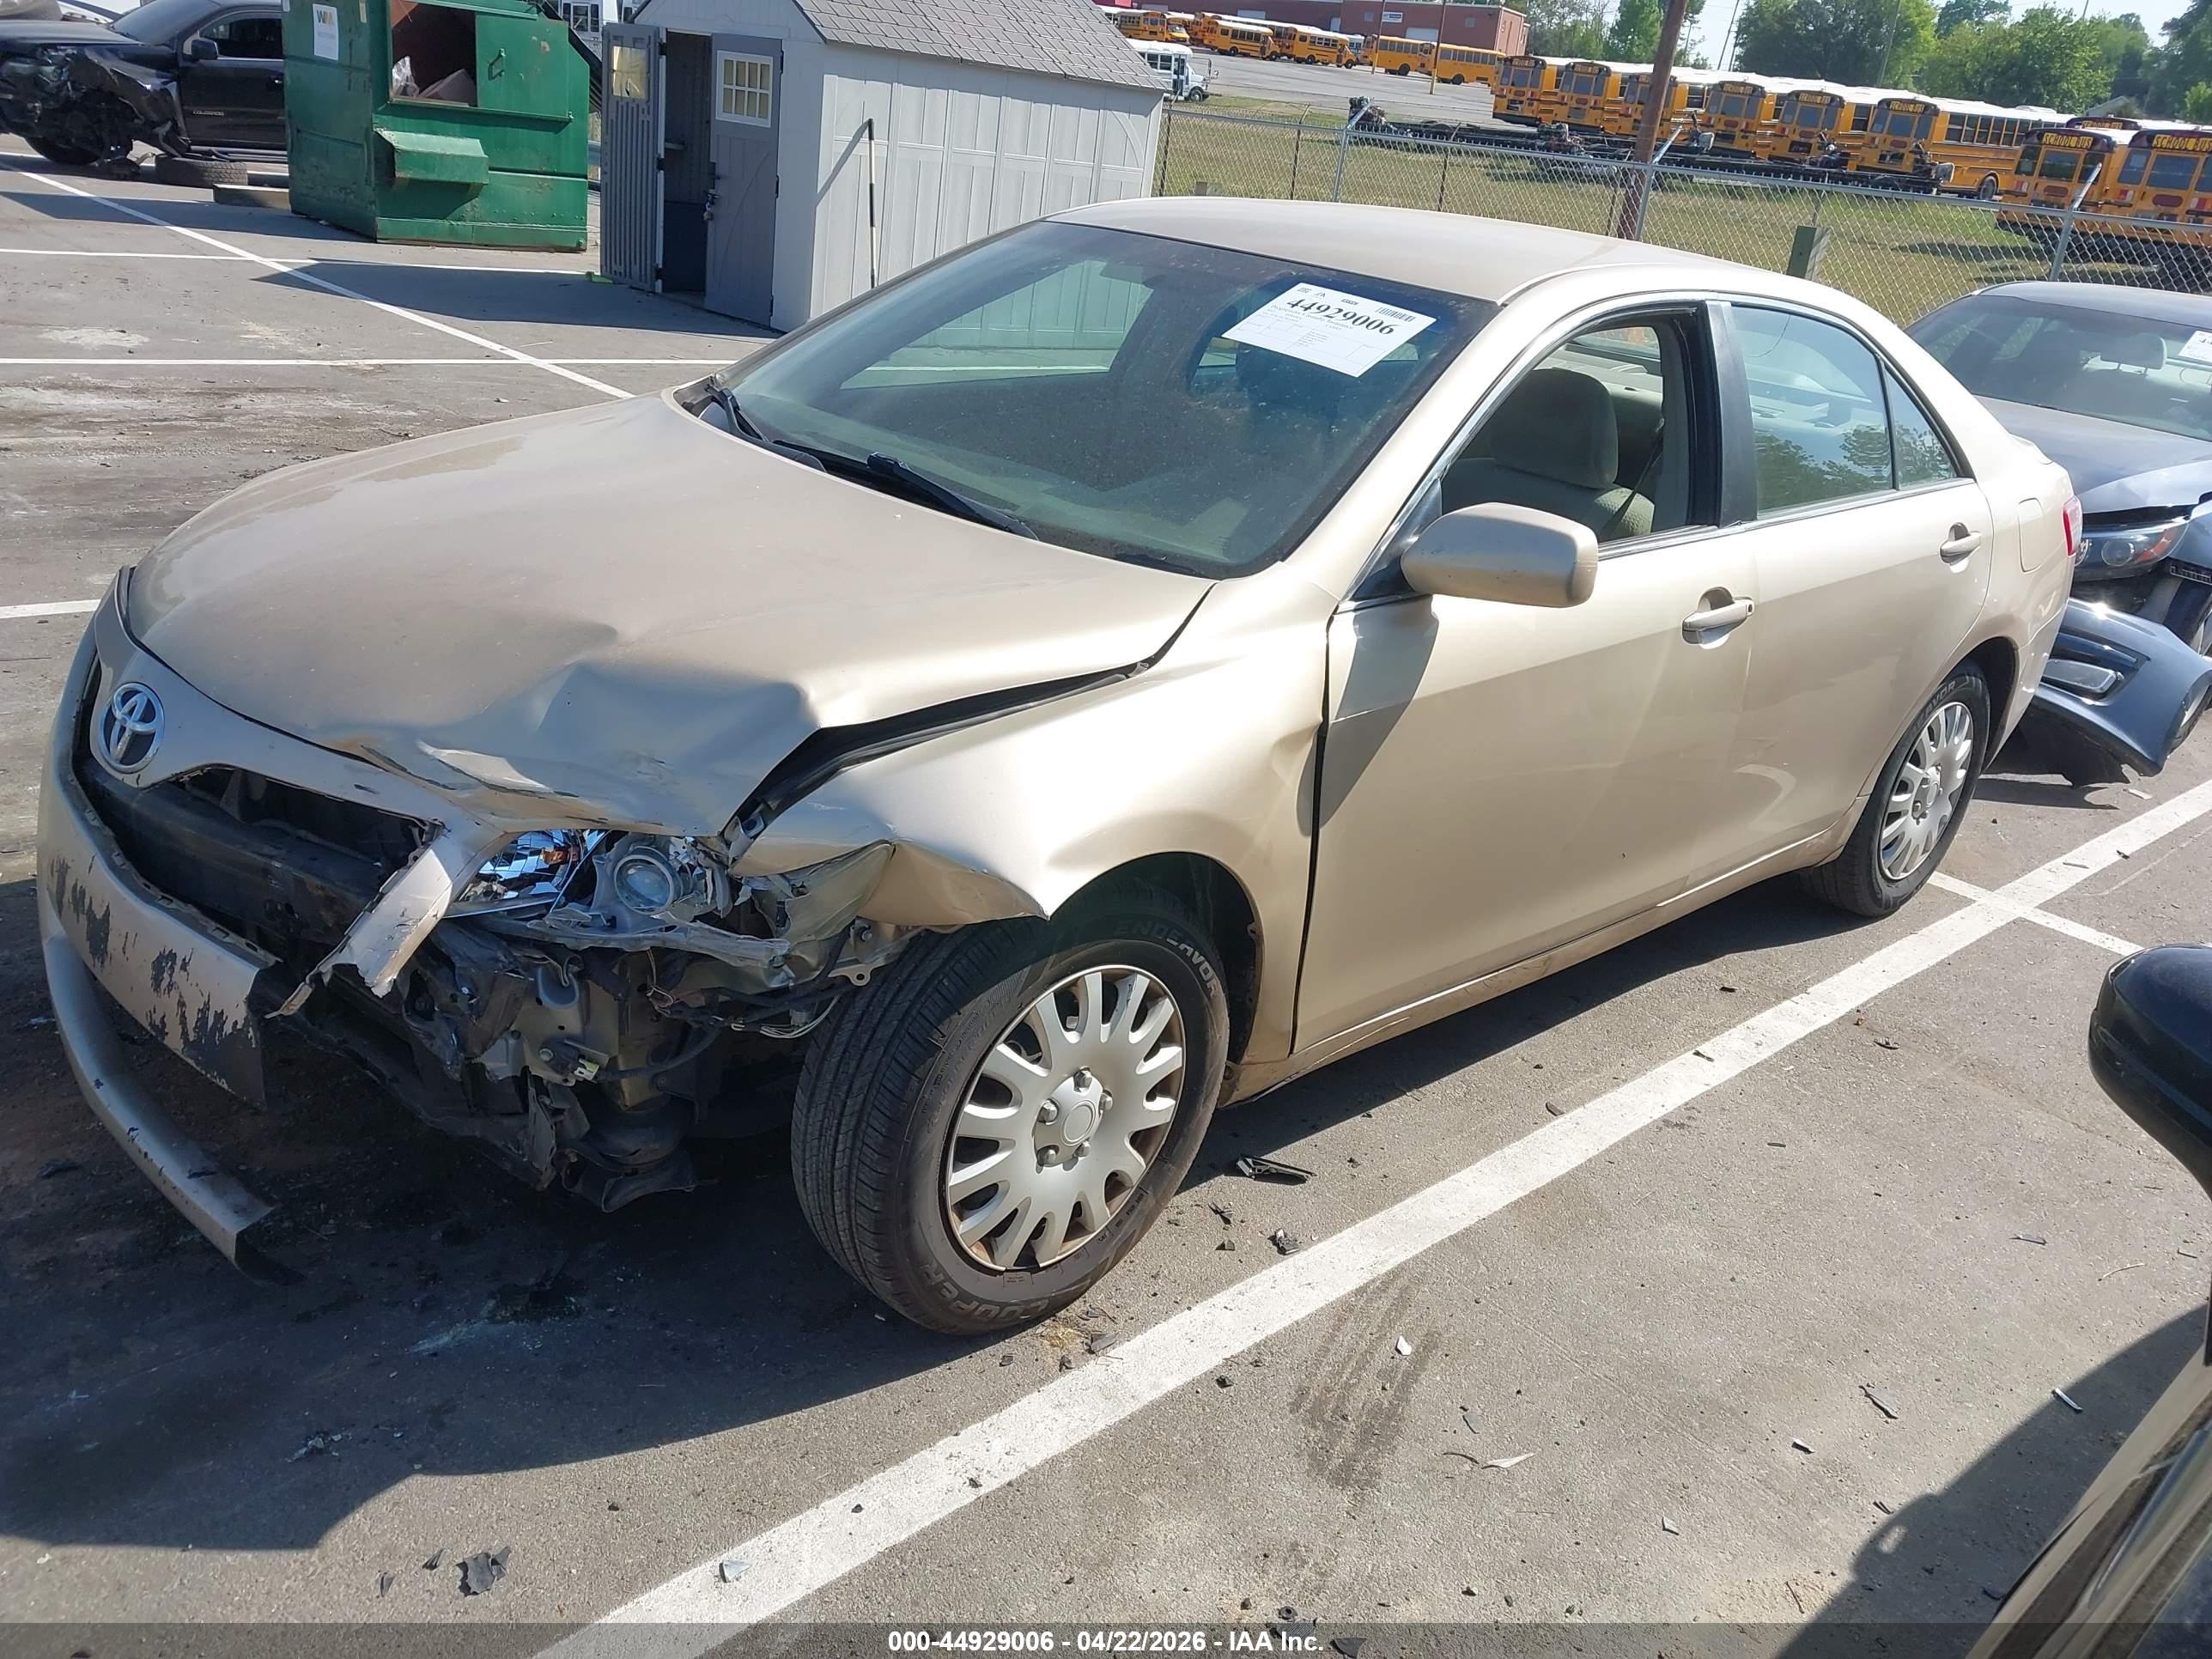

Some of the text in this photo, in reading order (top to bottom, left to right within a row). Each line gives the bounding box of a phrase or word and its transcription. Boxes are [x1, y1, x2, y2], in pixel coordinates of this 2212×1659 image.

[2045, 133, 2092, 149] SCHOOL BUS
[2155, 136, 2212, 152] SCHOOL BUS
[1286, 298, 1401, 335] 44929006
[1115, 920, 1219, 997] ENDEAVOR
[920, 1263, 1050, 1320] COOPER
